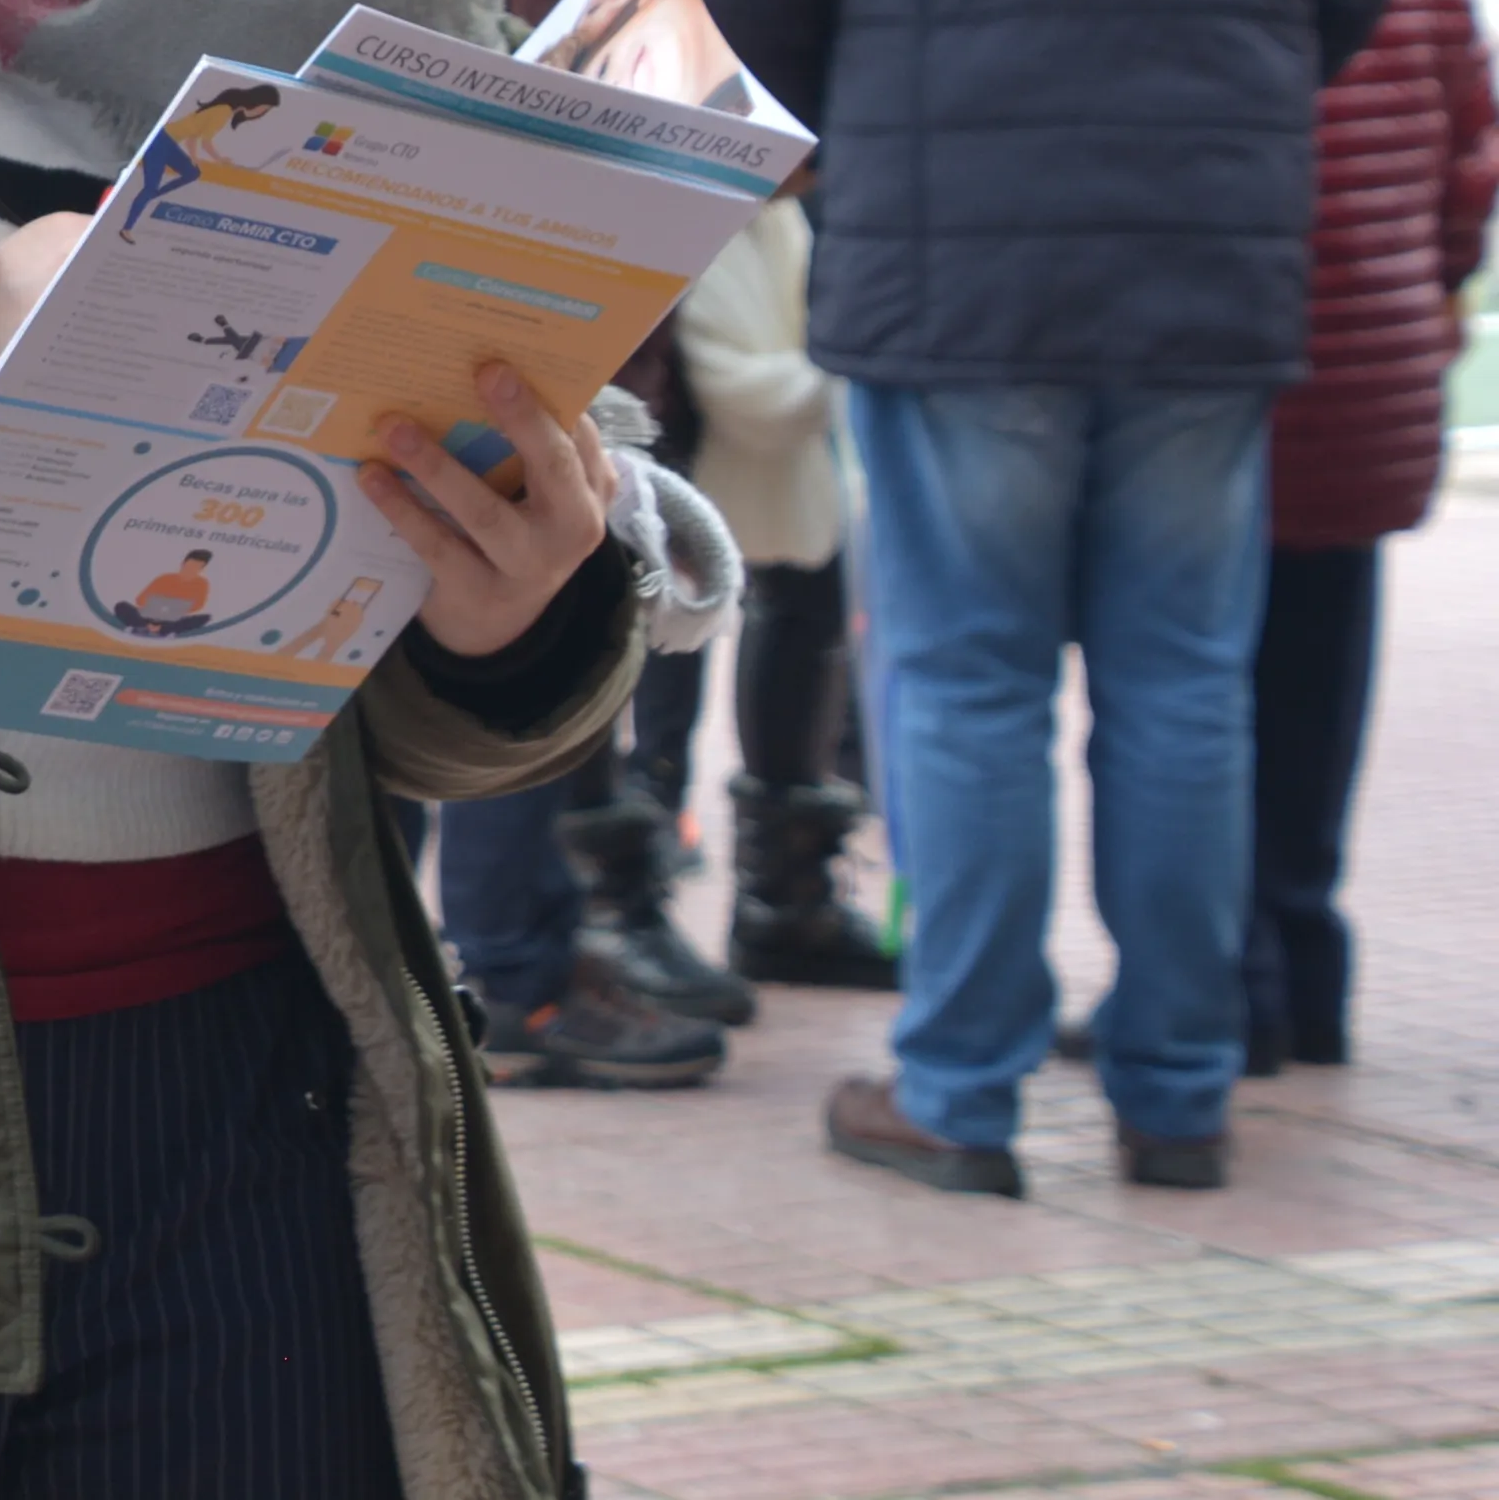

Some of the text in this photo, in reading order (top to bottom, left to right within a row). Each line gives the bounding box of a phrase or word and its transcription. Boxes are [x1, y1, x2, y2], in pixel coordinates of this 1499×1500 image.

[356, 34, 449, 79] CURSO
[451, 67, 592, 121] INTENSIVO
[596, 108, 648, 137] MIR
[647, 122, 772, 169] ASTURIAS
[390, 141, 421, 160] CTO
[216, 216, 275, 240] ReMIR
[276, 230, 318, 250] CTO
[466, 200, 485, 217] A
[490, 206, 532, 228] TUS
[535, 215, 619, 250] AMIGOS
[179, 473, 310, 507] Becas para las
[123, 516, 205, 540] primeras
[192, 497, 266, 529] 300
